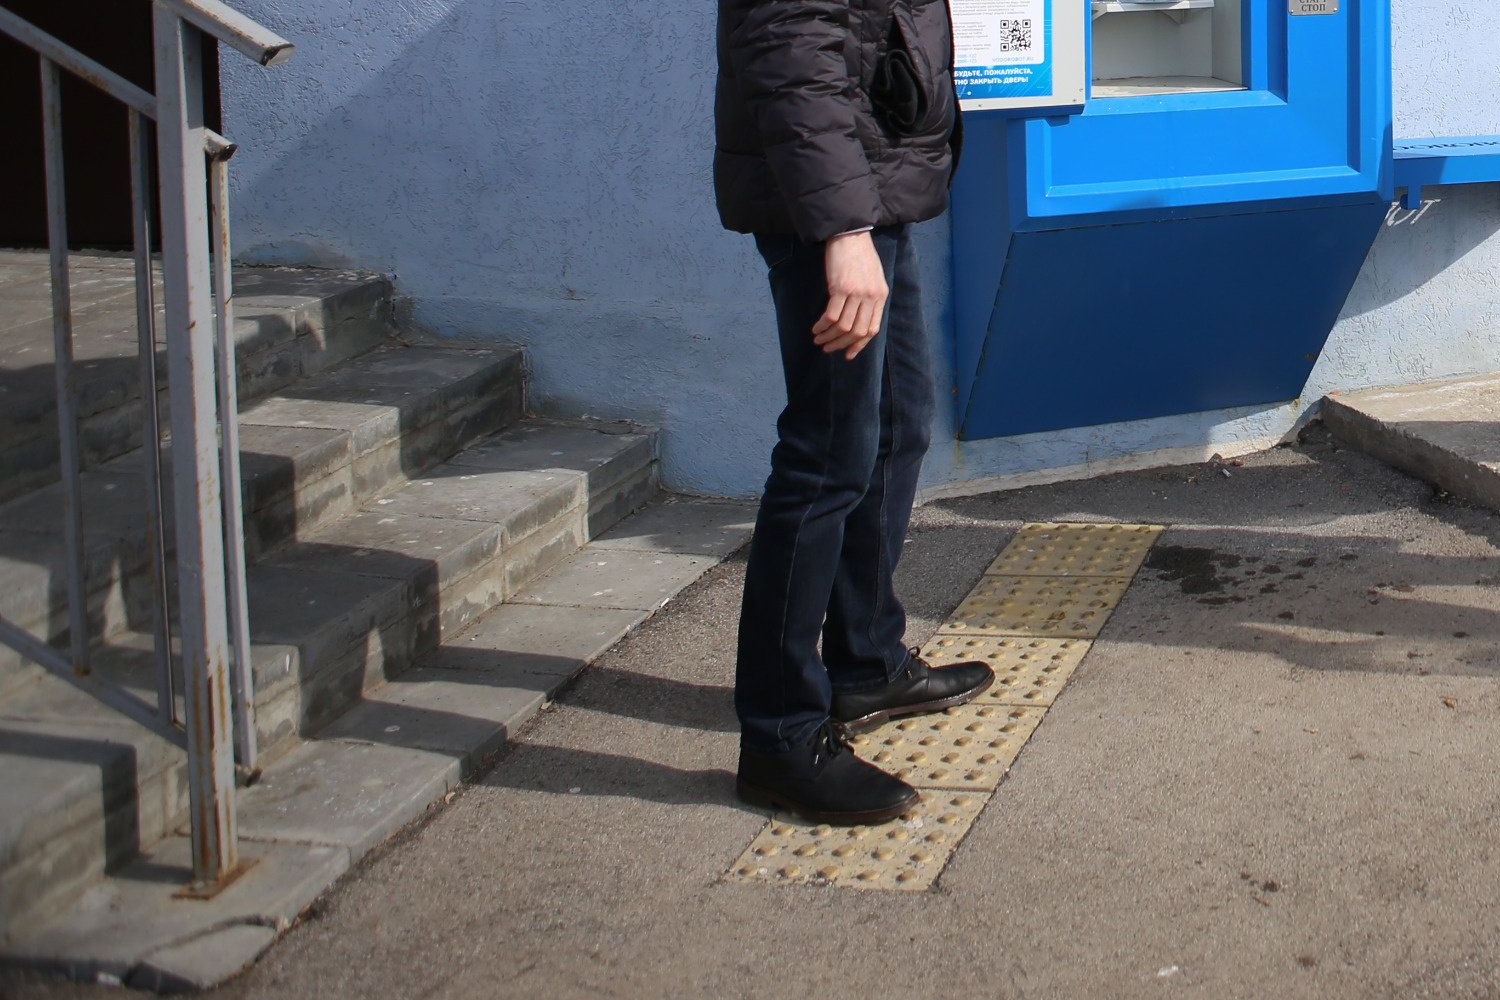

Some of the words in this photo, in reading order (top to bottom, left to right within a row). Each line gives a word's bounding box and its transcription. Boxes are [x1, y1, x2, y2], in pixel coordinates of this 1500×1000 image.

[1301, 3, 1326, 12] СТОП
[954, 70, 983, 78] БУДЬТЕ,
[984, 67, 1034, 76] ПОЖАЛУЙСТА,
[1003, 76, 1029, 84] ДВЕРЬ!
